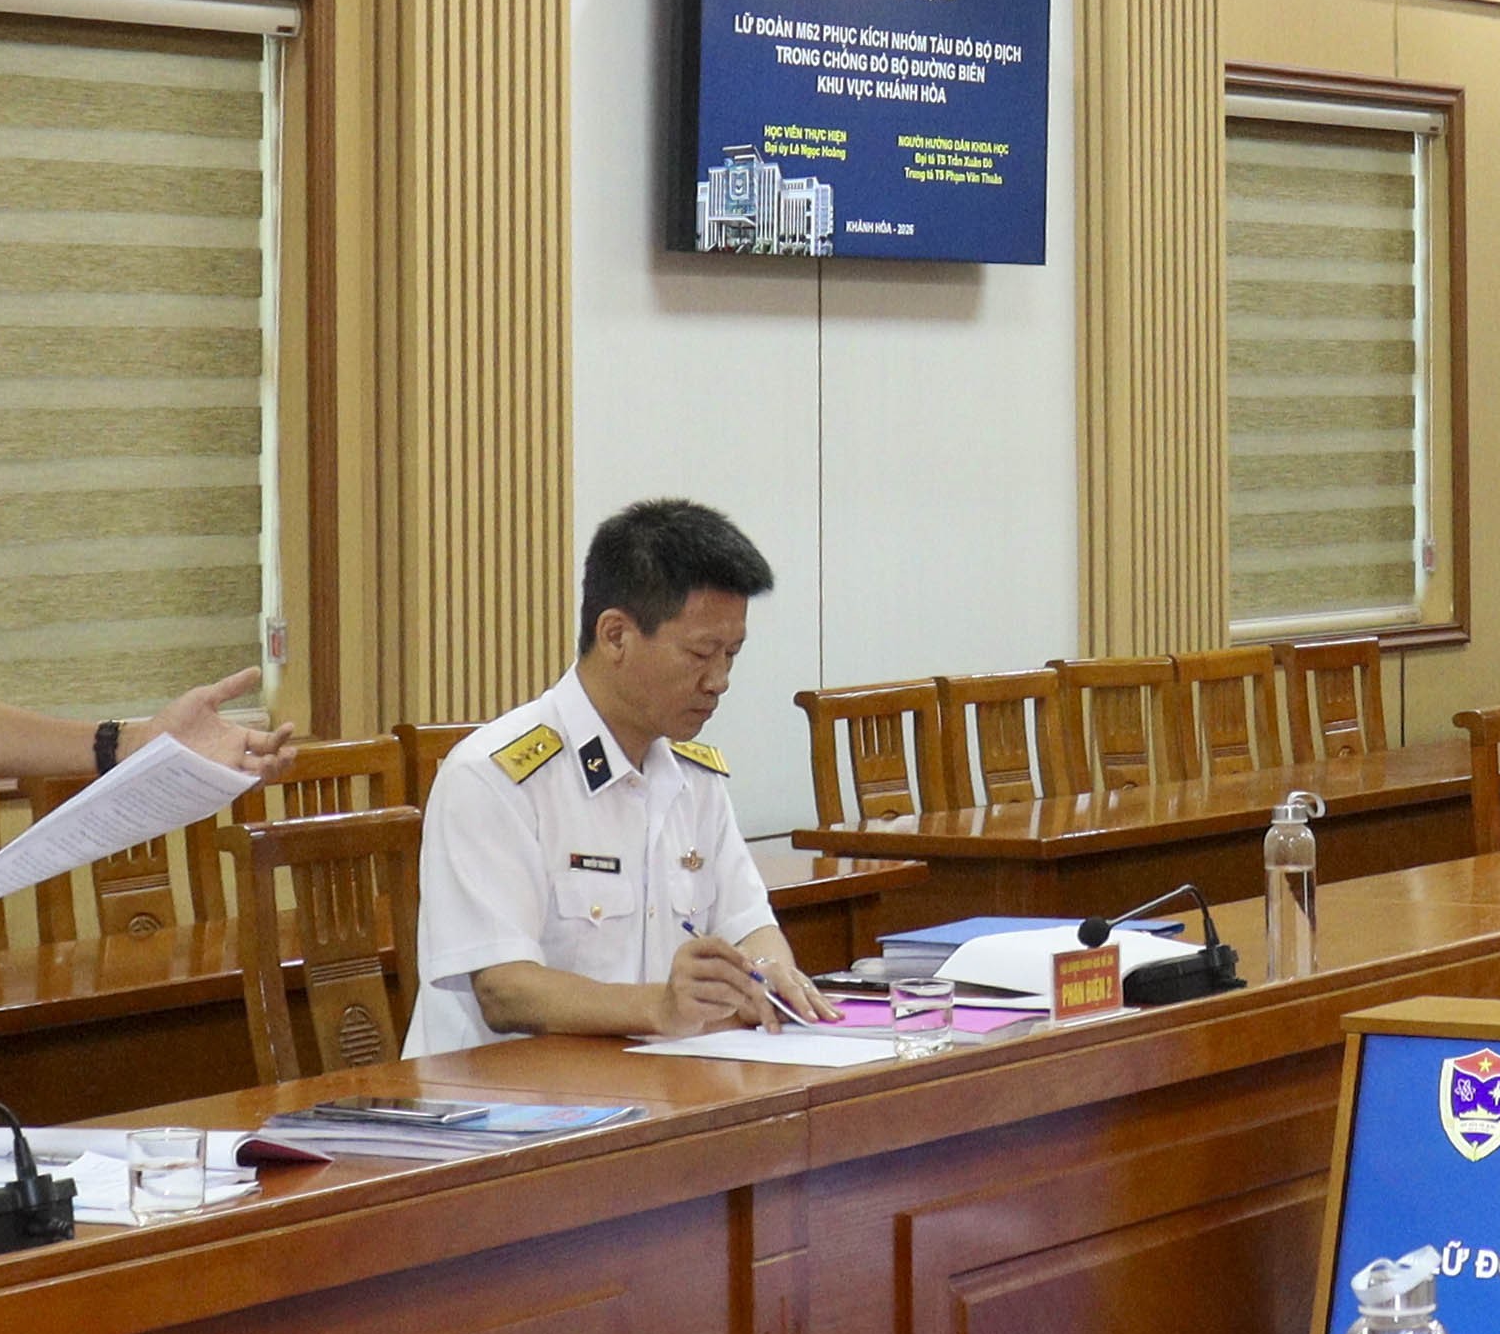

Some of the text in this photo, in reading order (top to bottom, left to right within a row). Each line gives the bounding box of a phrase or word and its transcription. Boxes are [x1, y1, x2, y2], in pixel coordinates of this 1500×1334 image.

[735, 12, 754, 34] LỮ
[756, 15, 793, 38] ĐOÀN
[796, 22, 820, 41] M62
[823, 25, 857, 52] PHỤC
[860, 26, 889, 48] KÍCH
[891, 31, 927, 52] NHÓM
[930, 34, 953, 55] TÀU
[975, 41, 992, 63] BỘ
[994, 44, 1021, 65] ĐỊCH
[776, 45, 820, 66] TRONG
[891, 56, 909, 79] BỘ
[911, 57, 955, 80] ĐƯỜNG
[817, 75, 946, 103] KHU VỰC KHÁNH HÒA
